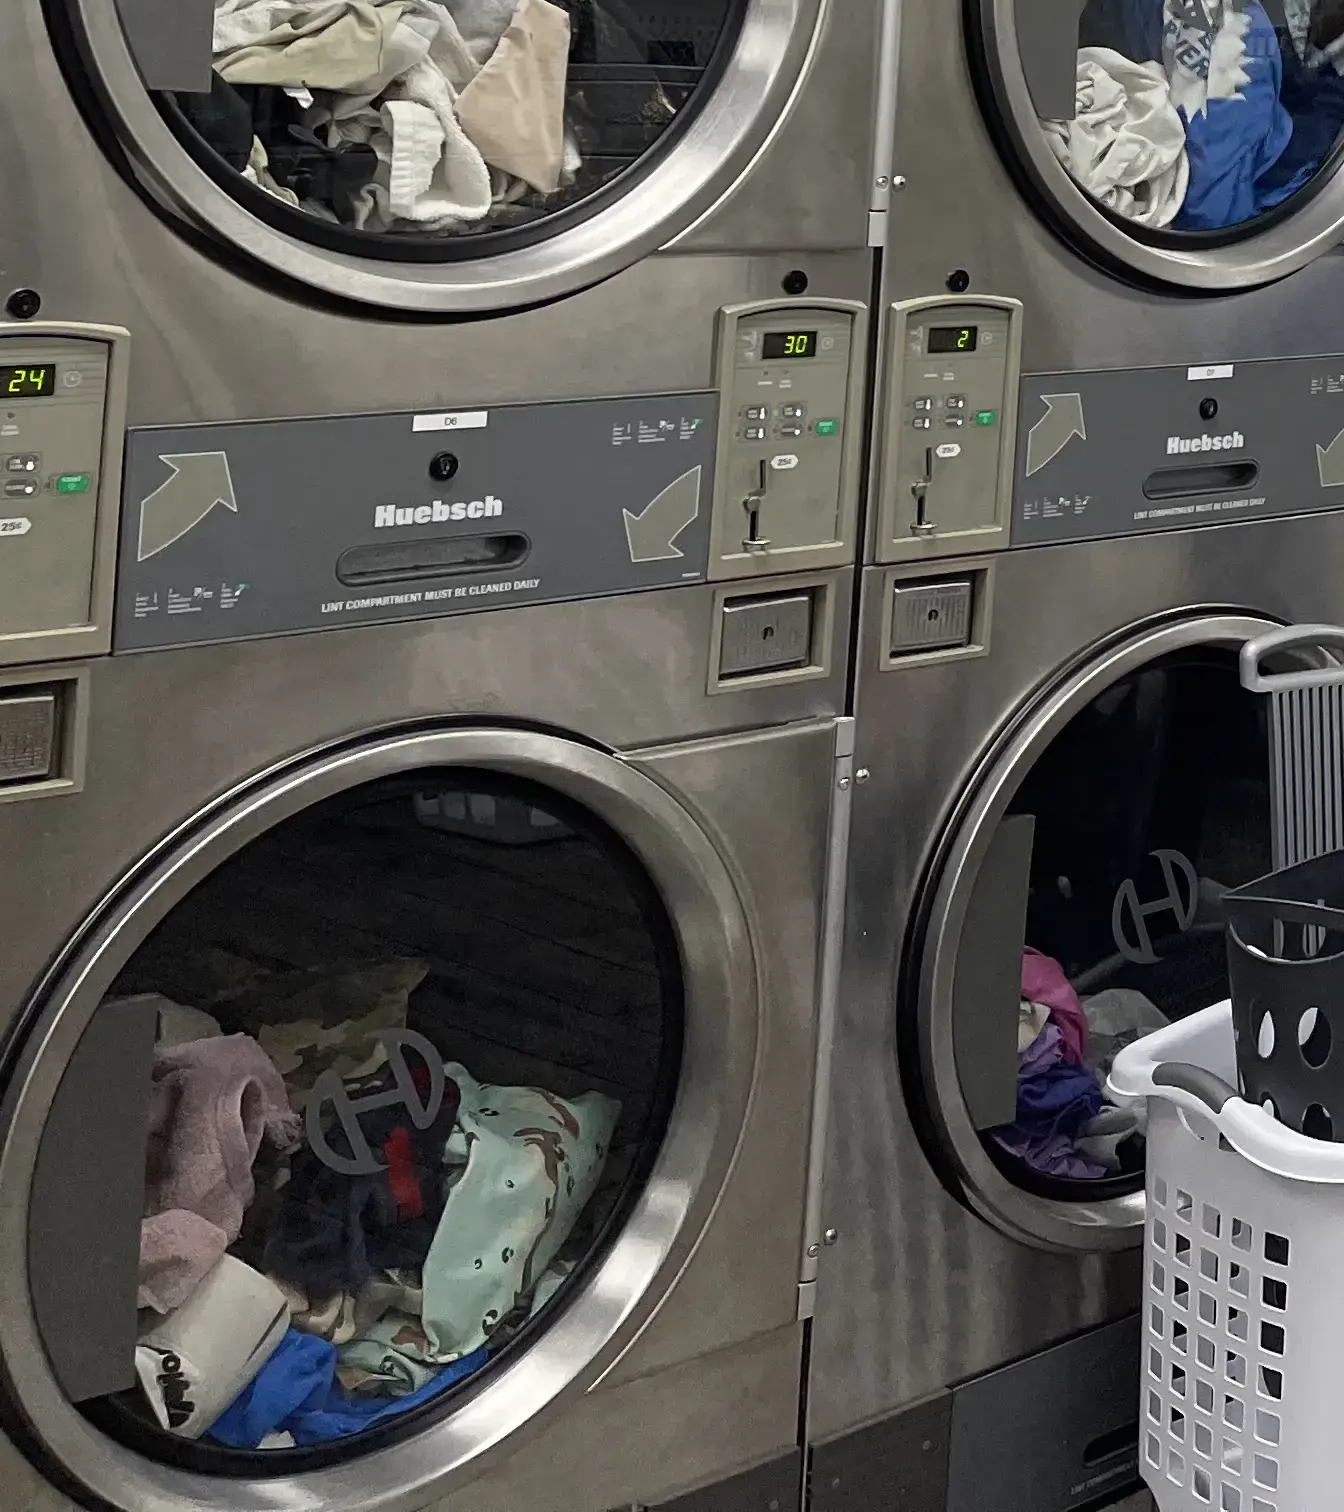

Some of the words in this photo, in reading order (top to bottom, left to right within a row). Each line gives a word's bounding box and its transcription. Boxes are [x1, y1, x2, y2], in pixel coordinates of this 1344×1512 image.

[784, 335, 808, 354] 30
[957, 330, 969, 348] 2
[8, 369, 46, 393] 24
[444, 416, 458, 426] D6
[1166, 431, 1244, 455] Huebsch
[374, 495, 503, 528] Huebsch
[321, 601, 345, 613] LINT
[345, 592, 422, 610] COMPARTMENT
[424, 588, 453, 601] MUST
[454, 586, 468, 597] BE
[469, 582, 512, 596] CLEANED
[513, 578, 540, 590] DAILY
